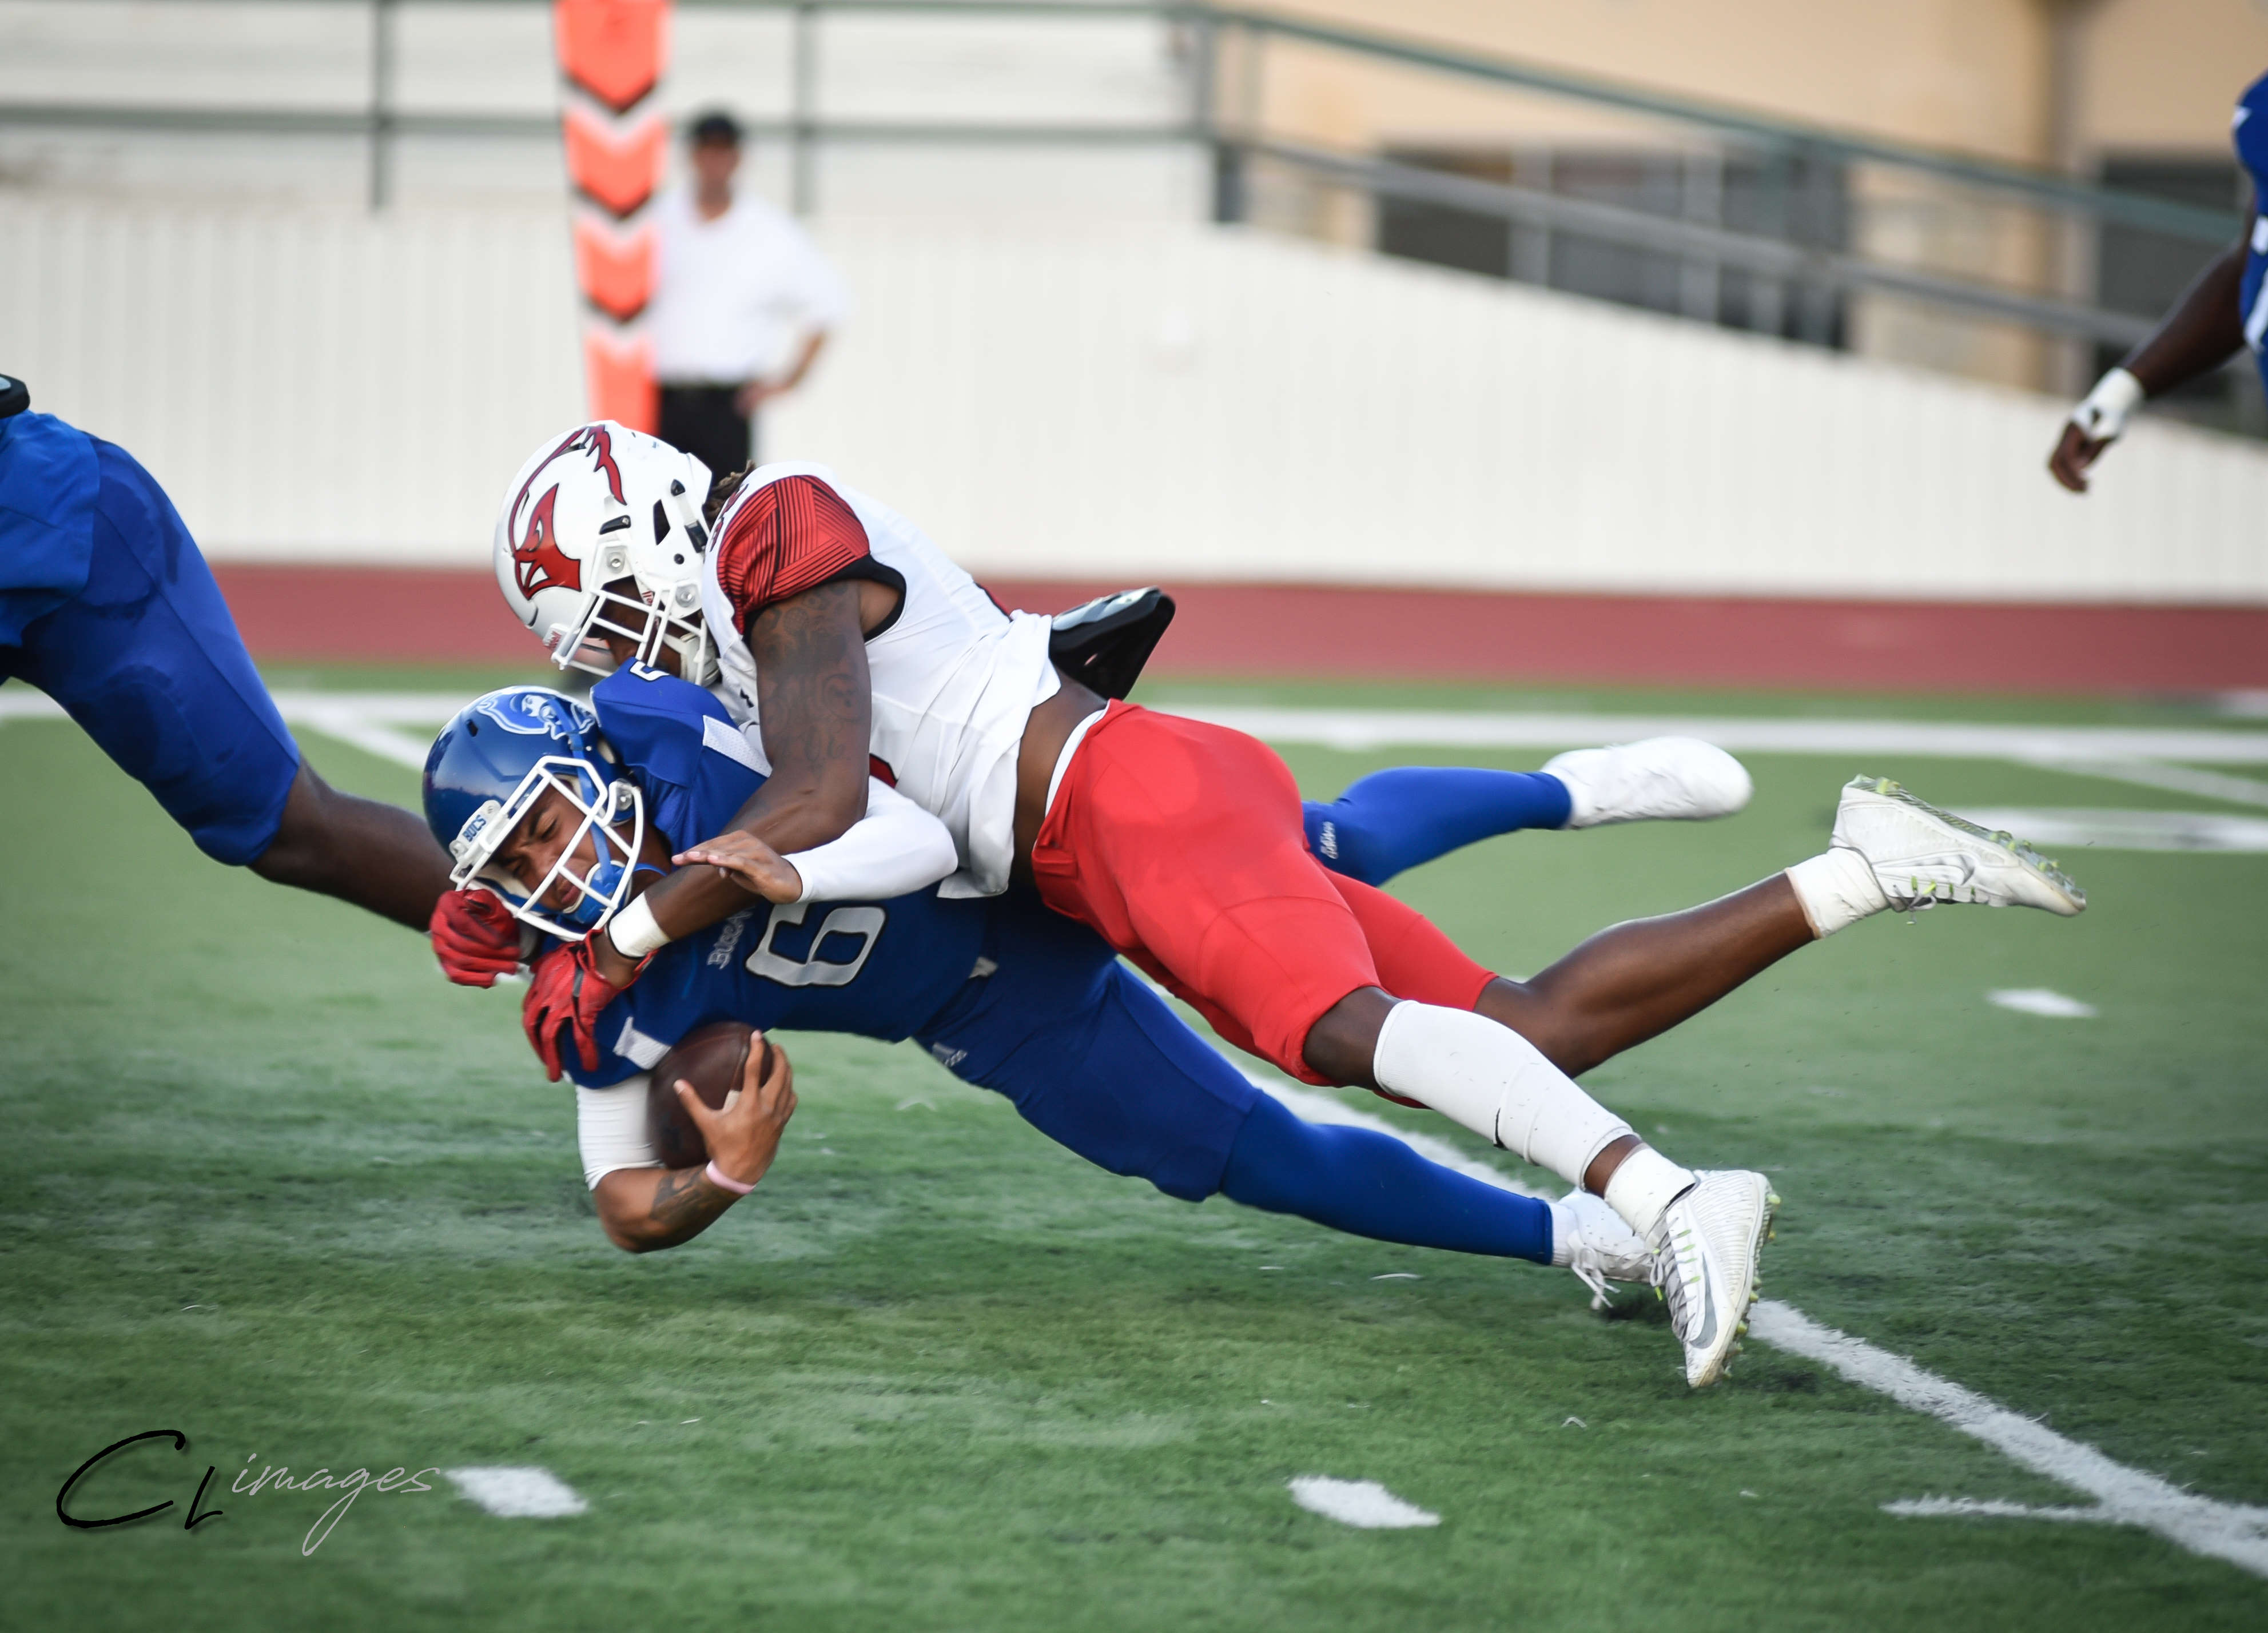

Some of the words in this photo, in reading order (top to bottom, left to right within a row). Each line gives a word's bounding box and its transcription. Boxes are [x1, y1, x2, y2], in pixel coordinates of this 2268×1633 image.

[462, 814, 487, 842] BUCS
[706, 906, 756, 970] BUCCA
[745, 900, 886, 987] 6
